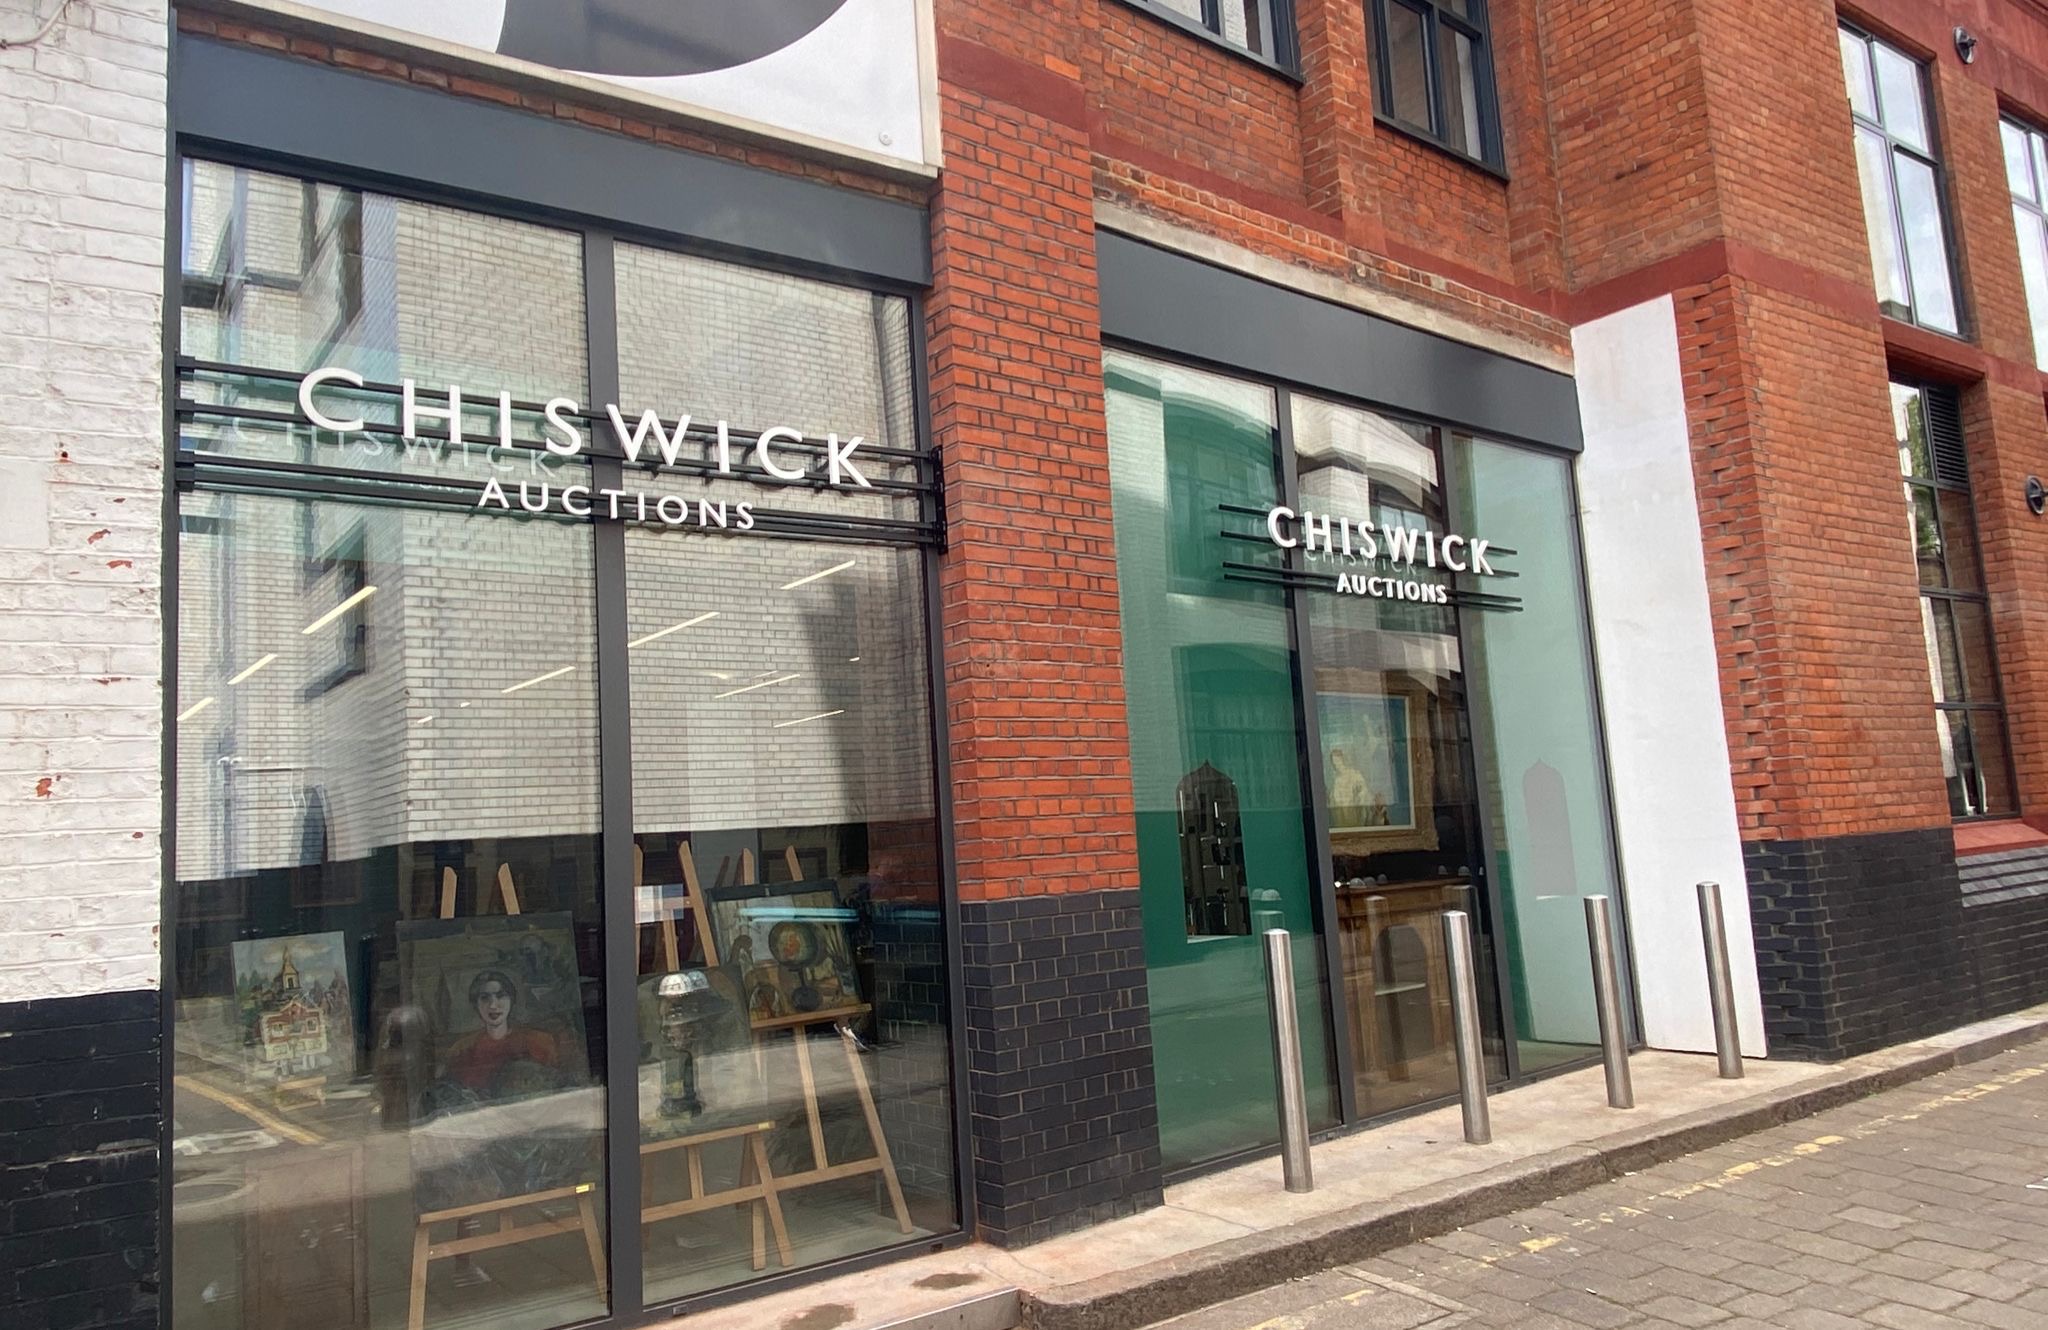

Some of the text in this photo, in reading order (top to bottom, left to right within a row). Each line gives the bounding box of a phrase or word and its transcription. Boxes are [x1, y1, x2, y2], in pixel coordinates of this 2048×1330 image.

[299, 367, 872, 489] CHISWICK
[477, 475, 755, 531] AUCTIONS
[1267, 506, 1495, 575] CHISWICK
[1337, 572, 1448, 604] AUCTIONS
